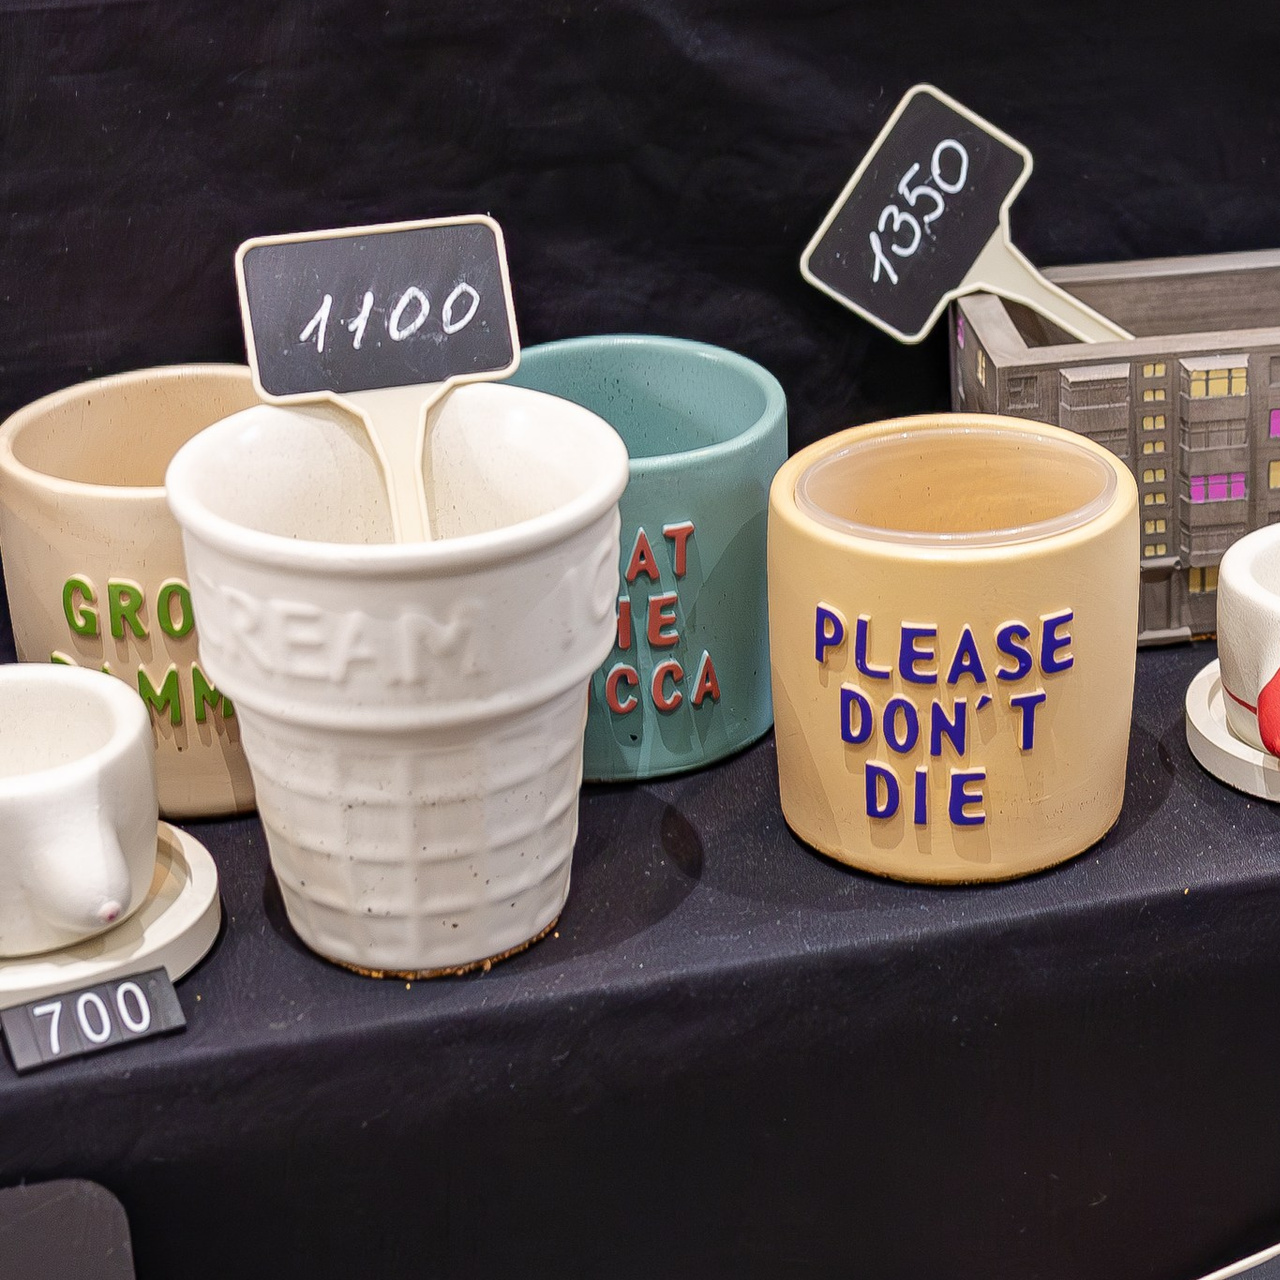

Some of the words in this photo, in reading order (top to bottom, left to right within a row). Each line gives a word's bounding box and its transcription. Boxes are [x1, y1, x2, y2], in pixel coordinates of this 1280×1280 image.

[869, 138, 969, 285] 1350
[299, 281, 481, 354] 1100
[625, 520, 695, 582] AT
[62, 573, 196, 638] GRO
[814, 602, 1075, 685] PLEASE
[606, 649, 721, 715] CCA
[840, 682, 1047, 757] DON'T
[865, 760, 987, 826] DIE
[32, 981, 151, 1055] 700
